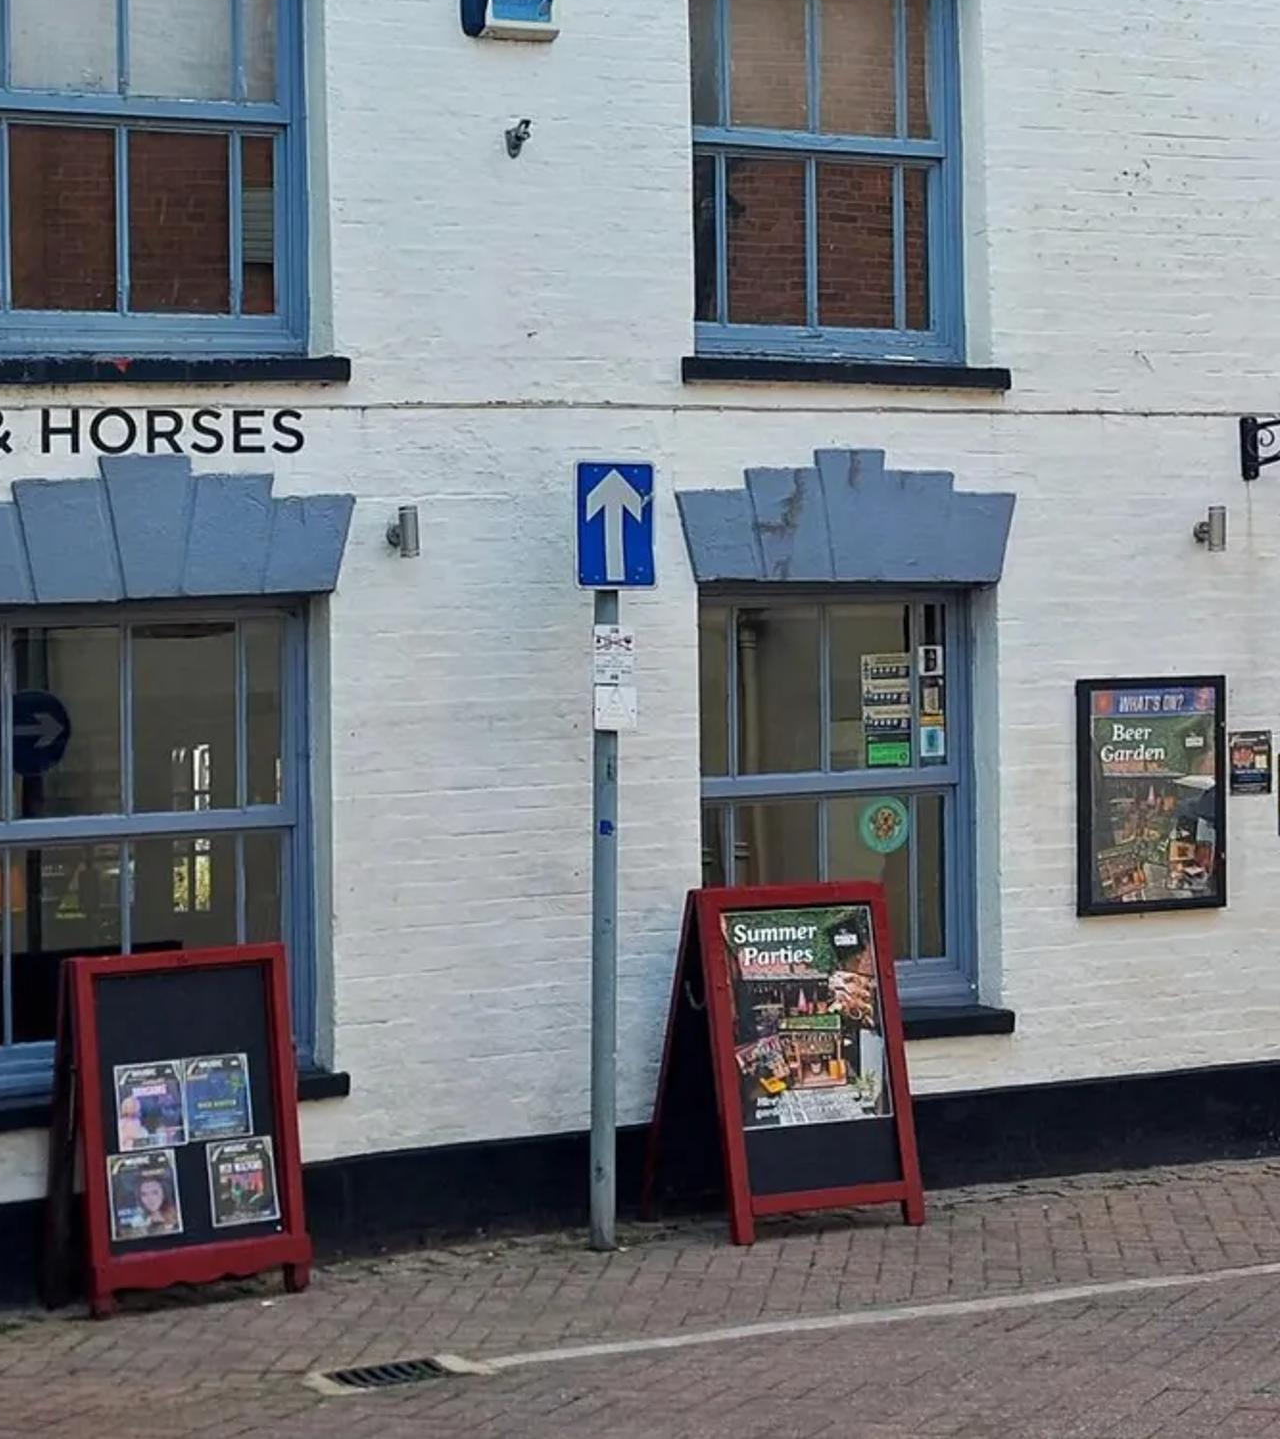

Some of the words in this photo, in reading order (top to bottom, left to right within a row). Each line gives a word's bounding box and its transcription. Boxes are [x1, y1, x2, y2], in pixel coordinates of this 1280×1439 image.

[39, 408, 306, 455] HORSES
[1112, 723, 1152, 742] Beer
[1100, 744, 1166, 763] Garden
[733, 923, 818, 944] Summer
[743, 945, 815, 967] Parties
